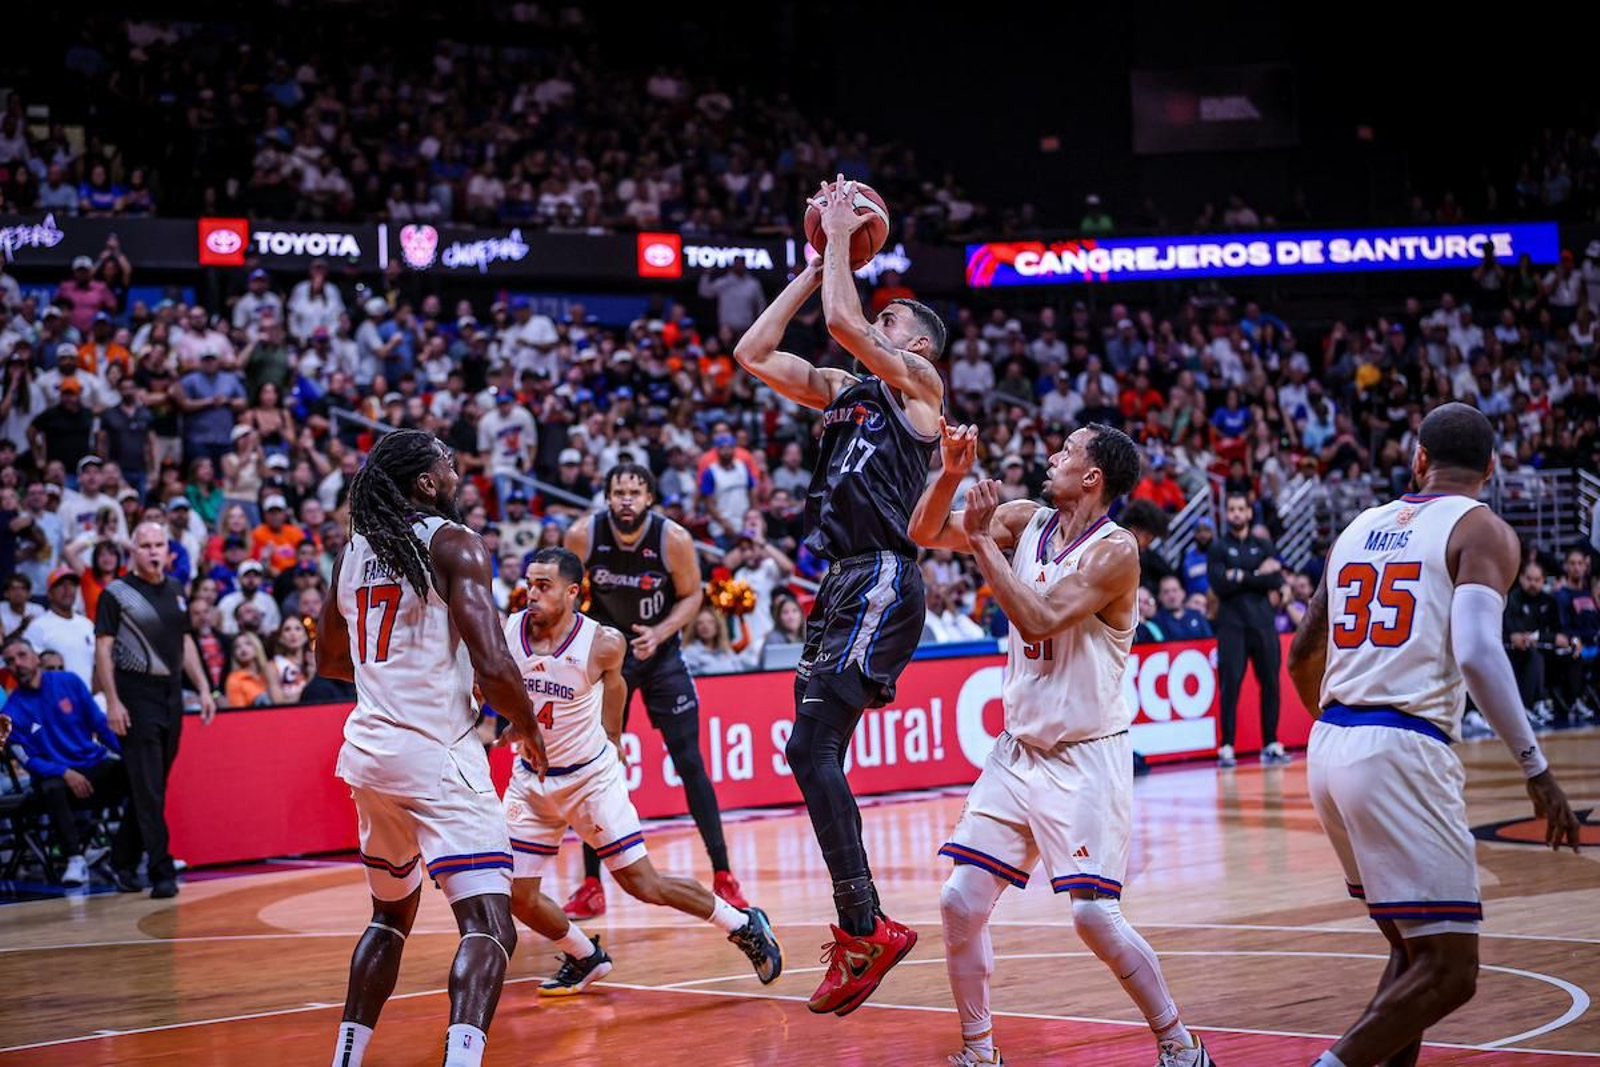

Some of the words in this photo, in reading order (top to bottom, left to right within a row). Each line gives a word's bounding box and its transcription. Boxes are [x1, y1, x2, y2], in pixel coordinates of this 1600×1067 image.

[254, 231, 361, 256] TOYOTA
[1014, 241, 1272, 276] CANGREJEROS
[1276, 240, 1325, 265] DE
[1328, 233, 1514, 263] SANTURCE
[840, 437, 877, 474] 27
[1364, 530, 1413, 551] MATIAS
[640, 590, 665, 619] 00
[1333, 561, 1422, 649] 35
[356, 583, 403, 664] 17
[537, 701, 554, 730] 4
[709, 716, 754, 783] la
[771, 697, 945, 778] sura!
